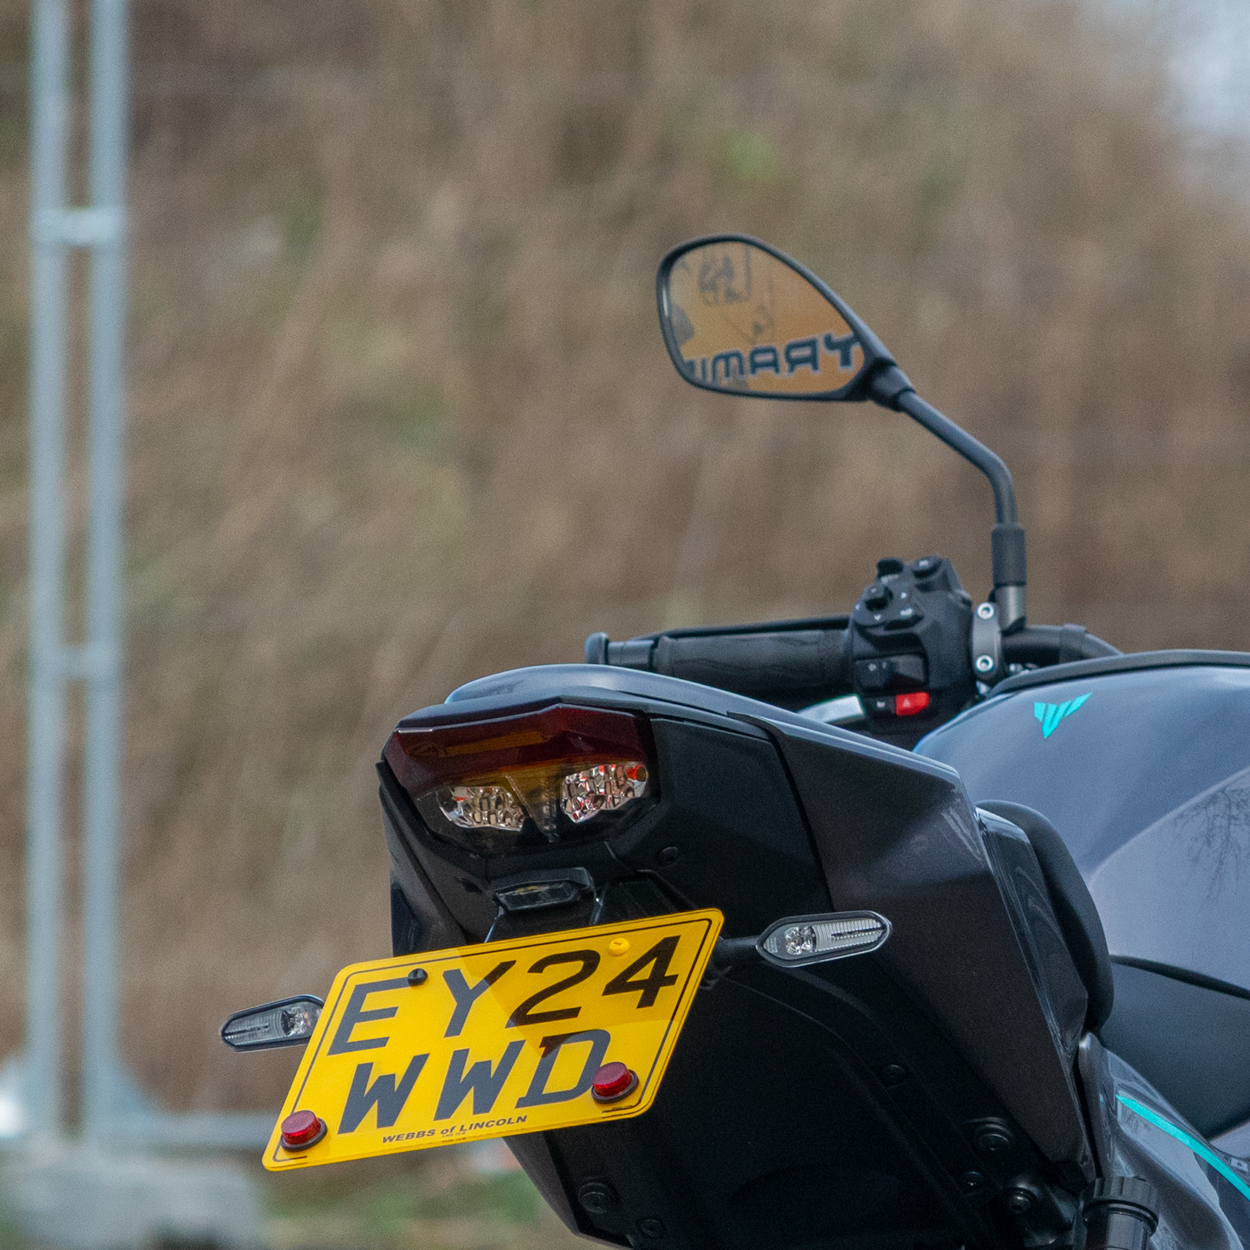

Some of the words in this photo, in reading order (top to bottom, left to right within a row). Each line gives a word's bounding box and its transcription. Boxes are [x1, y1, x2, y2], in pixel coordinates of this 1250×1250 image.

[327, 934, 682, 1056] EY24
[337, 1029, 611, 1135] WWD
[382, 1129, 436, 1143] WEBBS
[440, 1126, 456, 1135] of
[459, 1115, 527, 1132] LINCOLN
